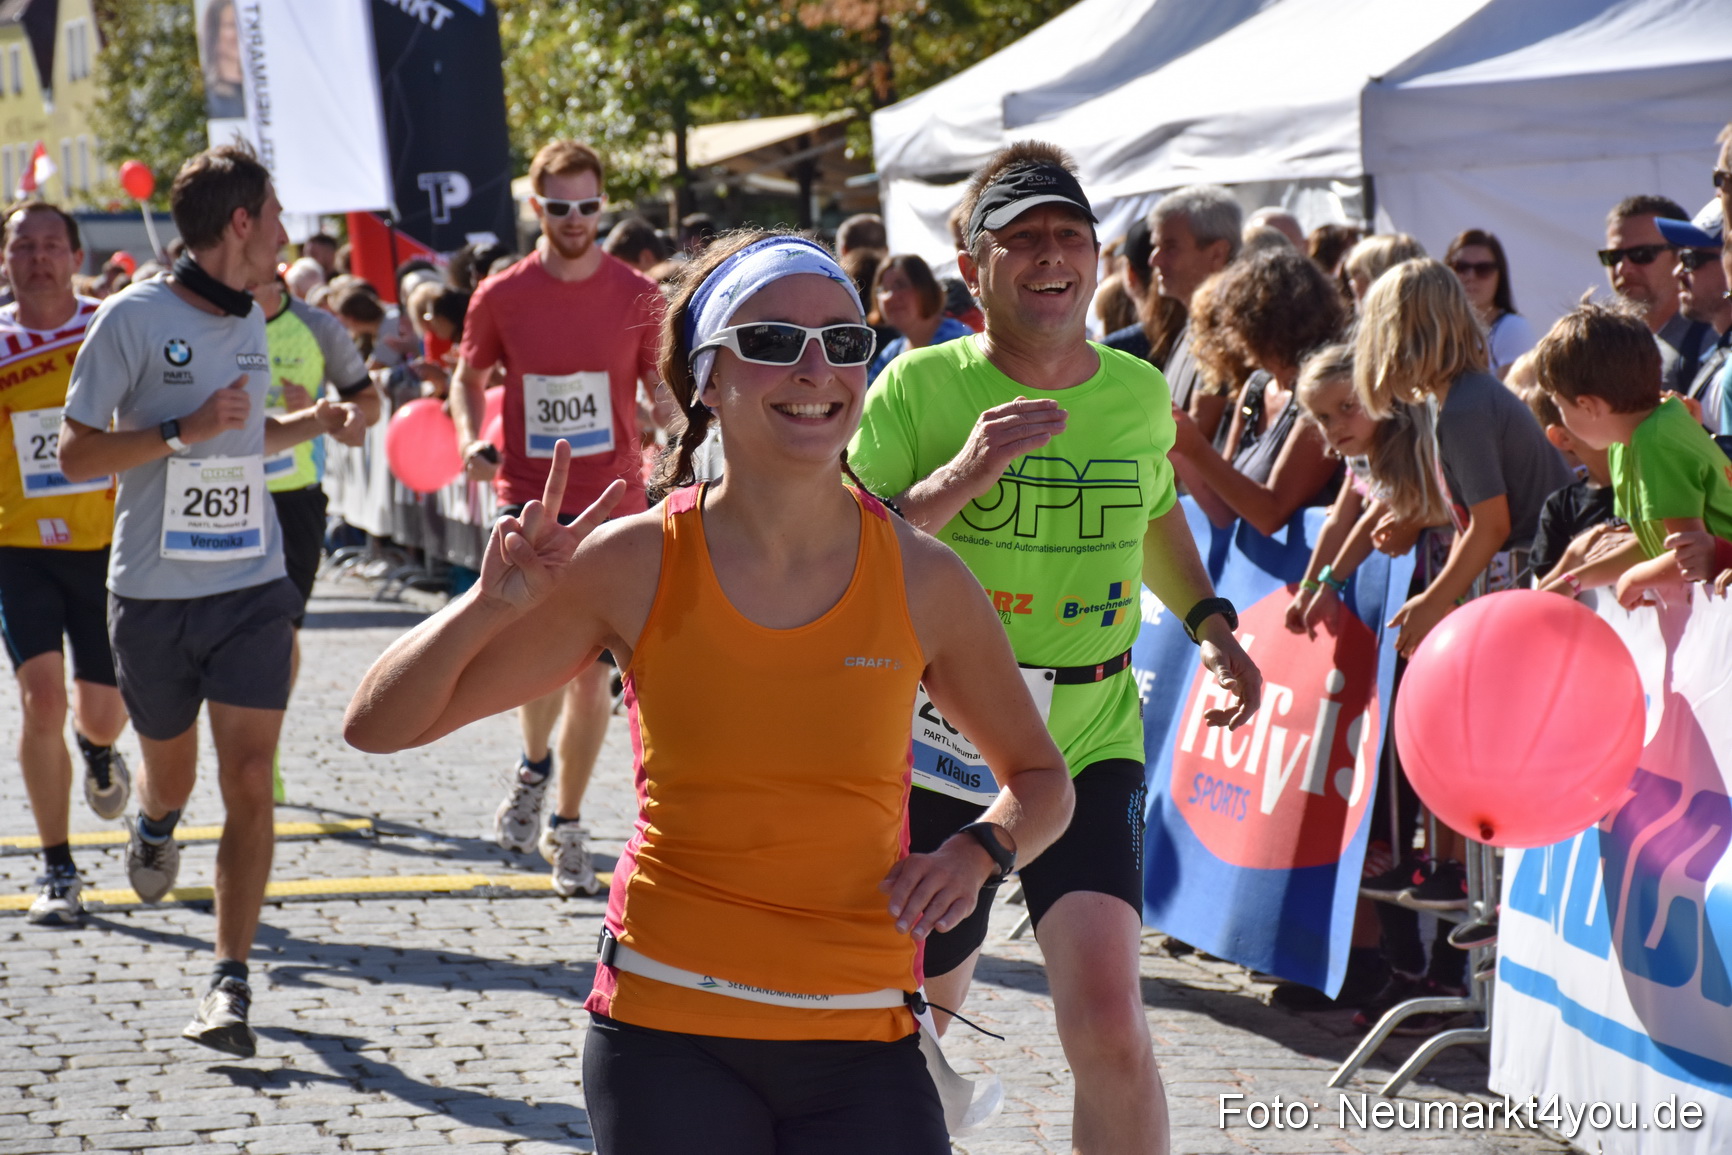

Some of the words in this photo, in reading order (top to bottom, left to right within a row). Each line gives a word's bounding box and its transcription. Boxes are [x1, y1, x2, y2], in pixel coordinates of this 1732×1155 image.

[537, 393, 597, 424] 3004
[183, 485, 250, 518] 2631
[190, 534, 244, 549] Veronika
[951, 532, 994, 548] Gebäude-
[995, 540, 1013, 551] und
[1014, 542, 1117, 555] Automatisierungstechnik
[1118, 538, 1139, 548] GmbH
[844, 656, 893, 669] CRAFT
[923, 728, 952, 748] PARTL
[935, 754, 981, 789] Klaus
[1188, 771, 1251, 822] SPORTS
